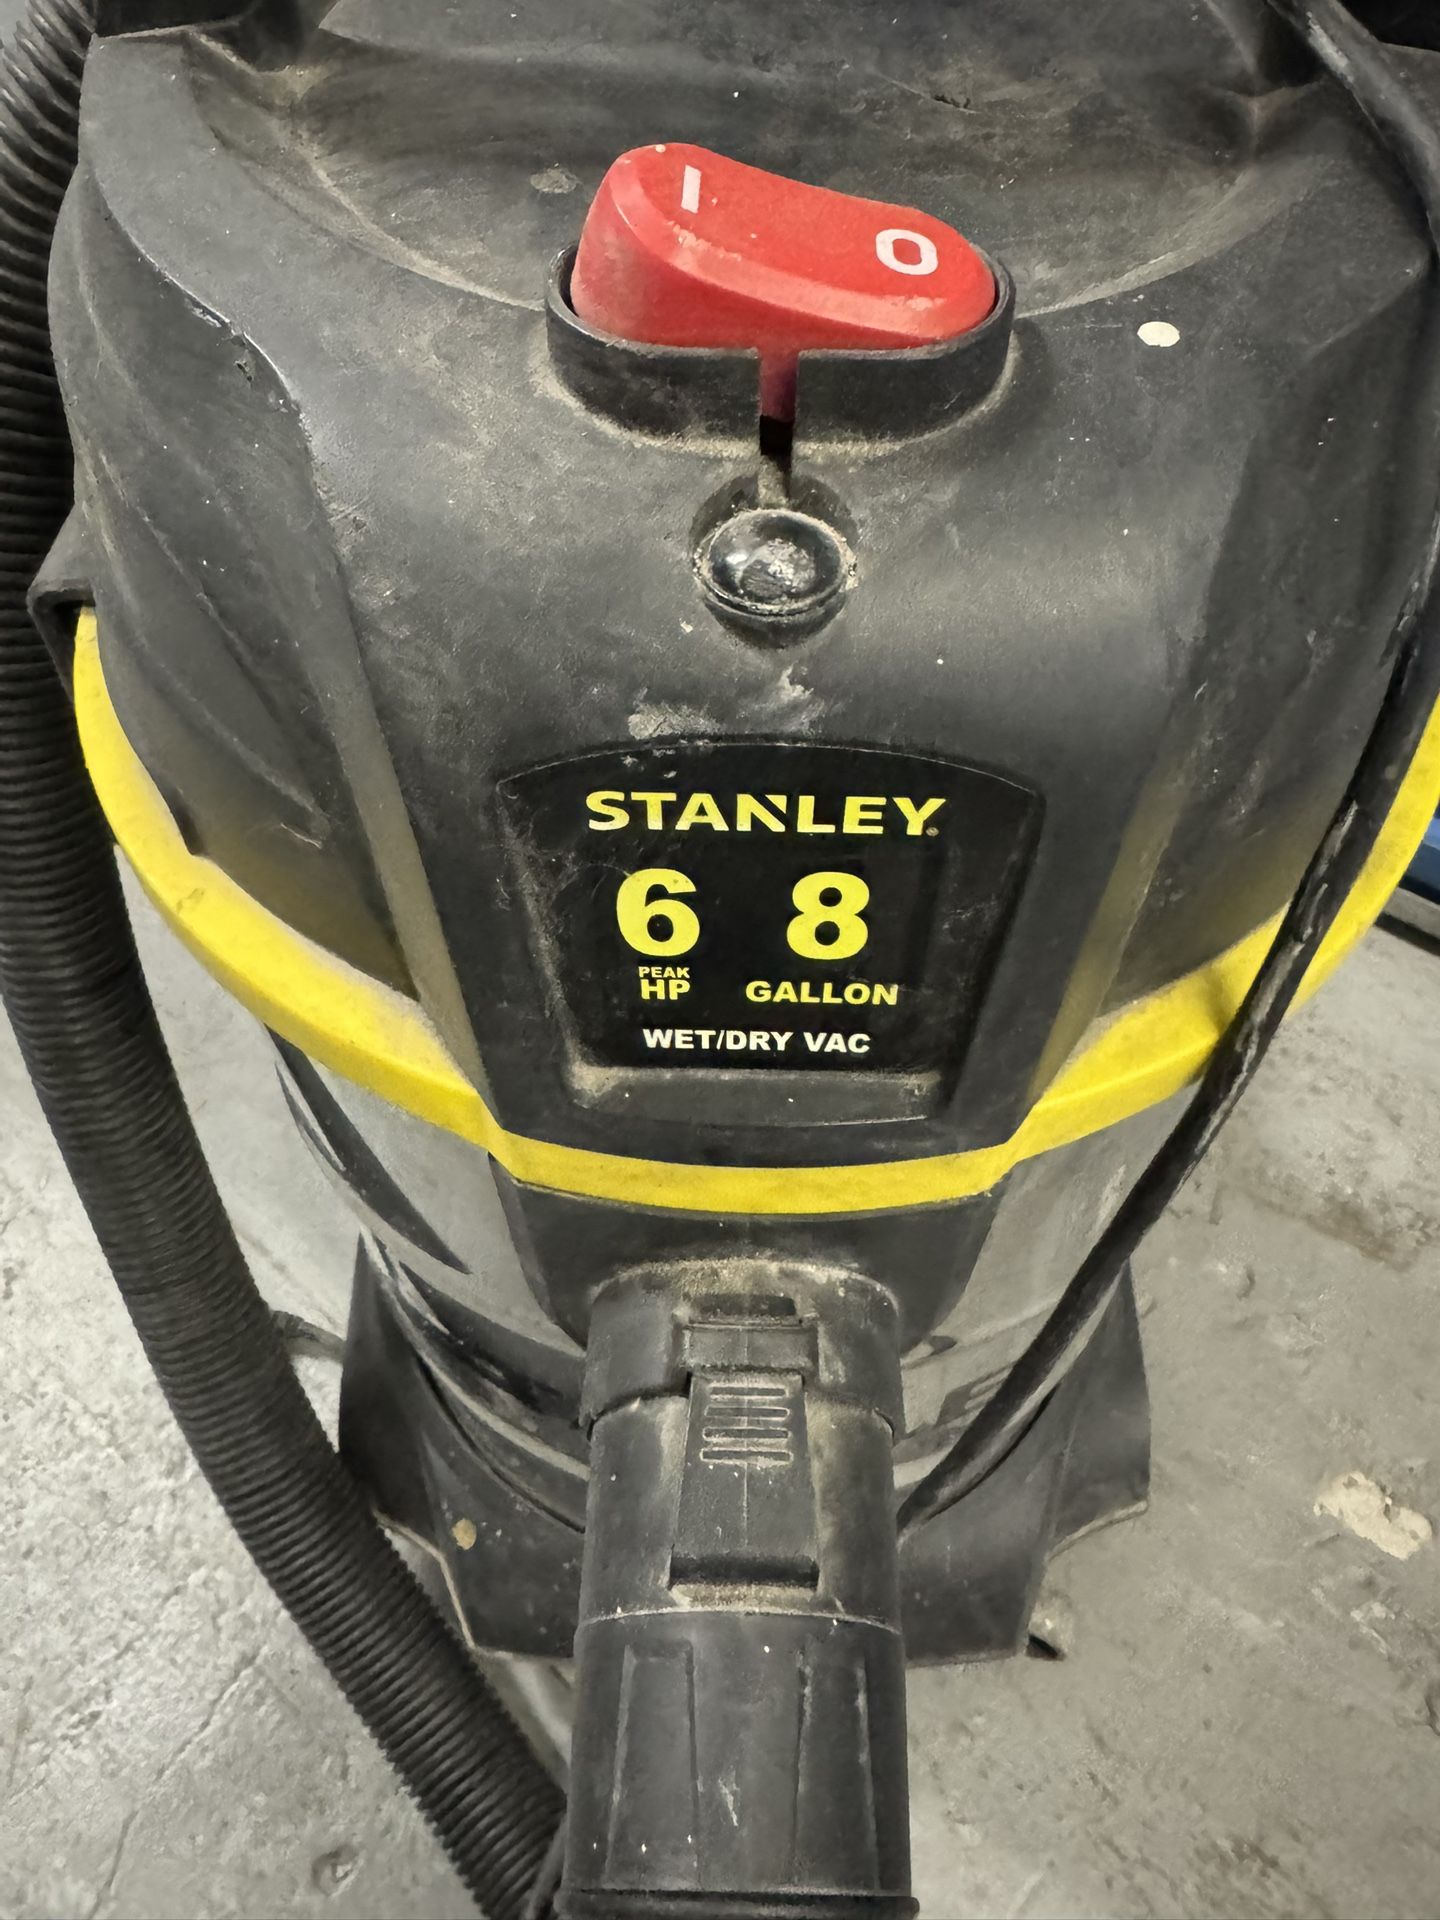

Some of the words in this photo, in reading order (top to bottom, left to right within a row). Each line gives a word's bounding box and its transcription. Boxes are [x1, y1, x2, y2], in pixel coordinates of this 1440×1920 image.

[585, 790, 947, 836] STANLEY
[616, 867, 701, 957] 6
[786, 871, 871, 961] 8
[638, 966, 690, 978] PEAK
[640, 979, 691, 1001] HP
[745, 980, 899, 1006] GALLON
[642, 1028, 794, 1052] WET/DRY
[804, 1031, 871, 1054] VAC
